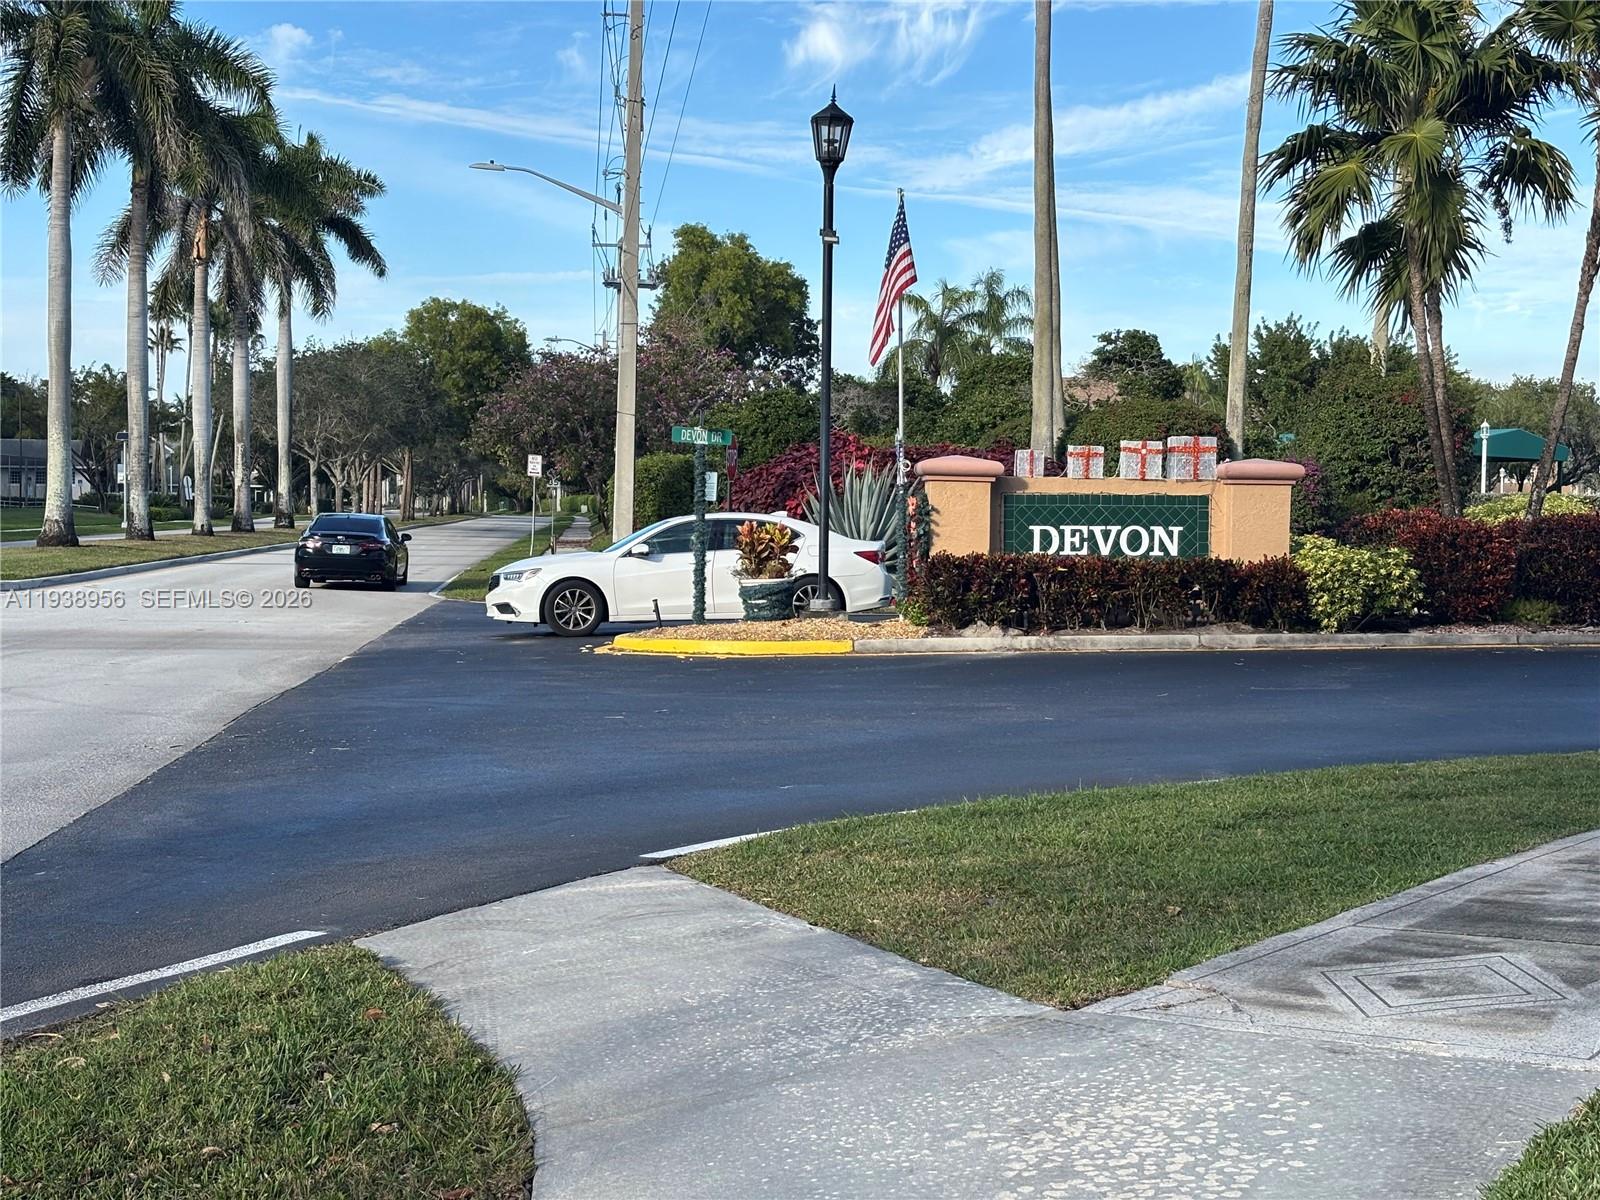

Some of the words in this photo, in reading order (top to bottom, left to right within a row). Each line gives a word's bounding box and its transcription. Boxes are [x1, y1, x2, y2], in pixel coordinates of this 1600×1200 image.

[681, 429, 708, 441] DEVON
[711, 431, 723, 443] DR
[1028, 525, 1184, 557] DEVON
